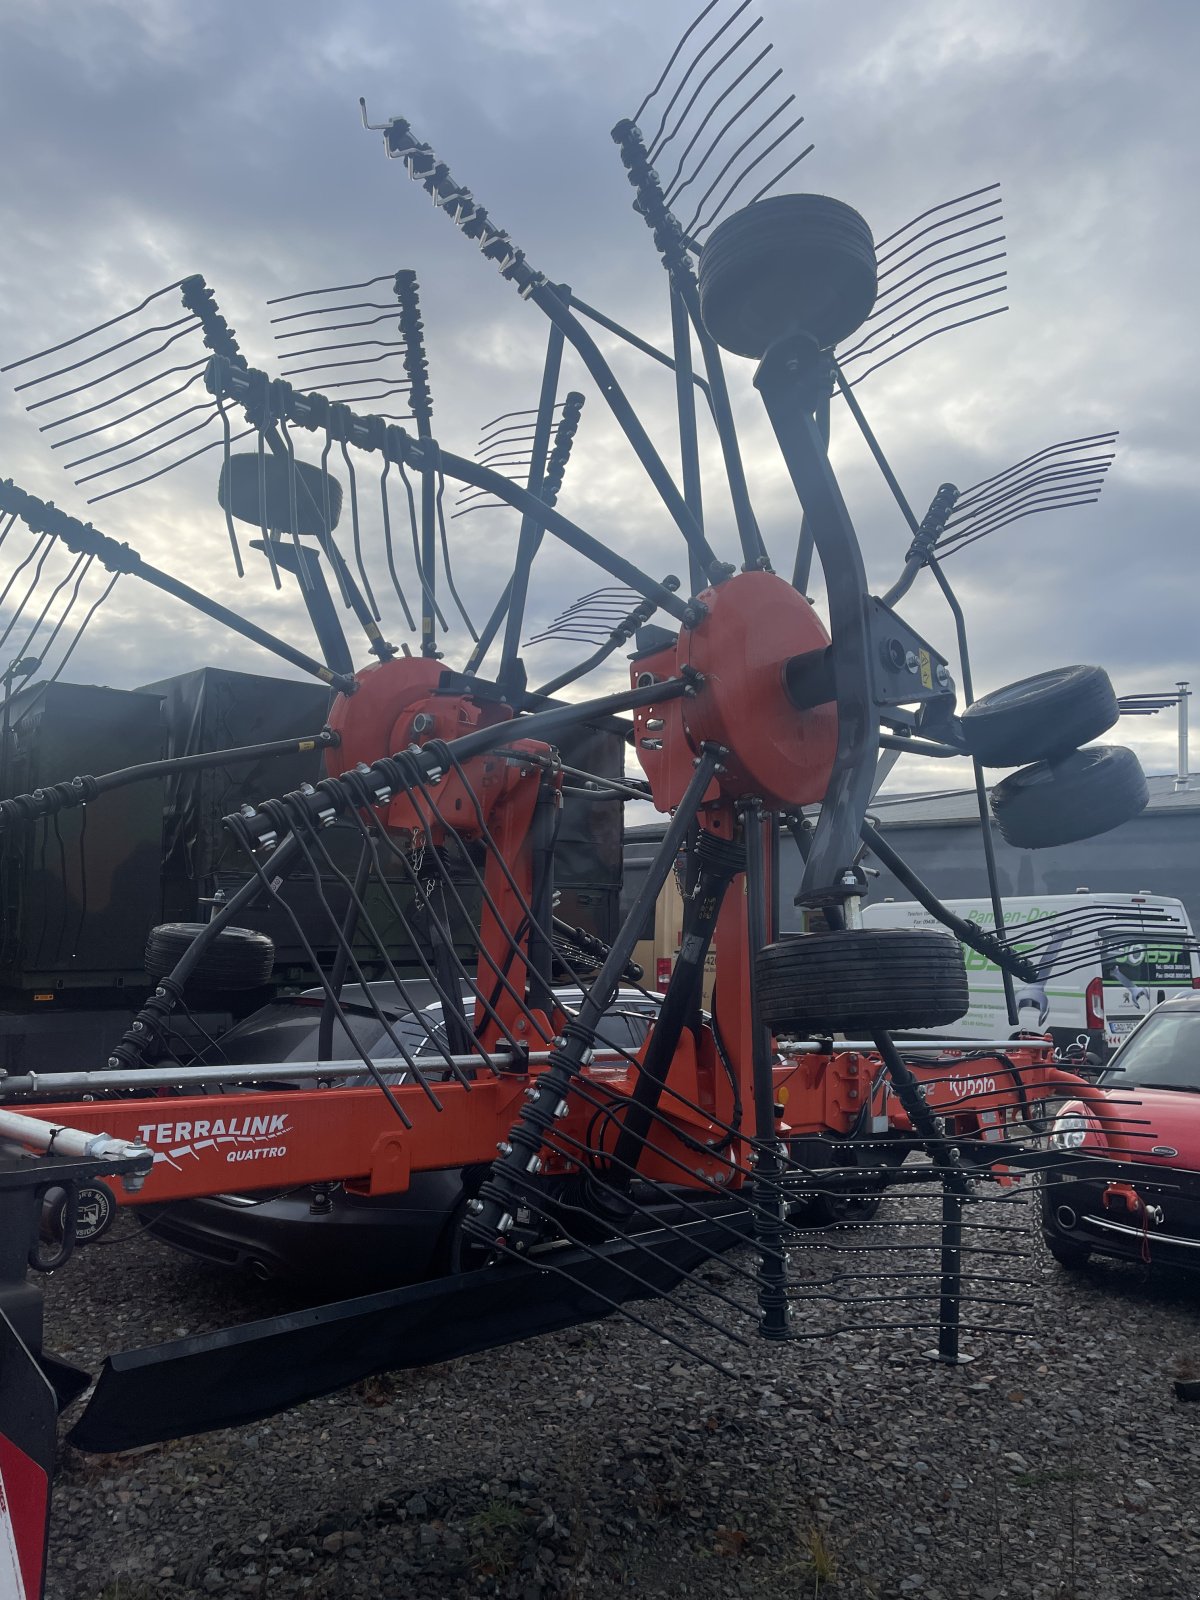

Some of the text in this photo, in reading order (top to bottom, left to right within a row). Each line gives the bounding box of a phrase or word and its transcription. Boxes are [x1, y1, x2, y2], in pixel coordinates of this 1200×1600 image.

[949, 1074, 996, 1097] Kubota
[138, 1114, 289, 1144] TERRALINK
[226, 1146, 287, 1163] QUATTRO
